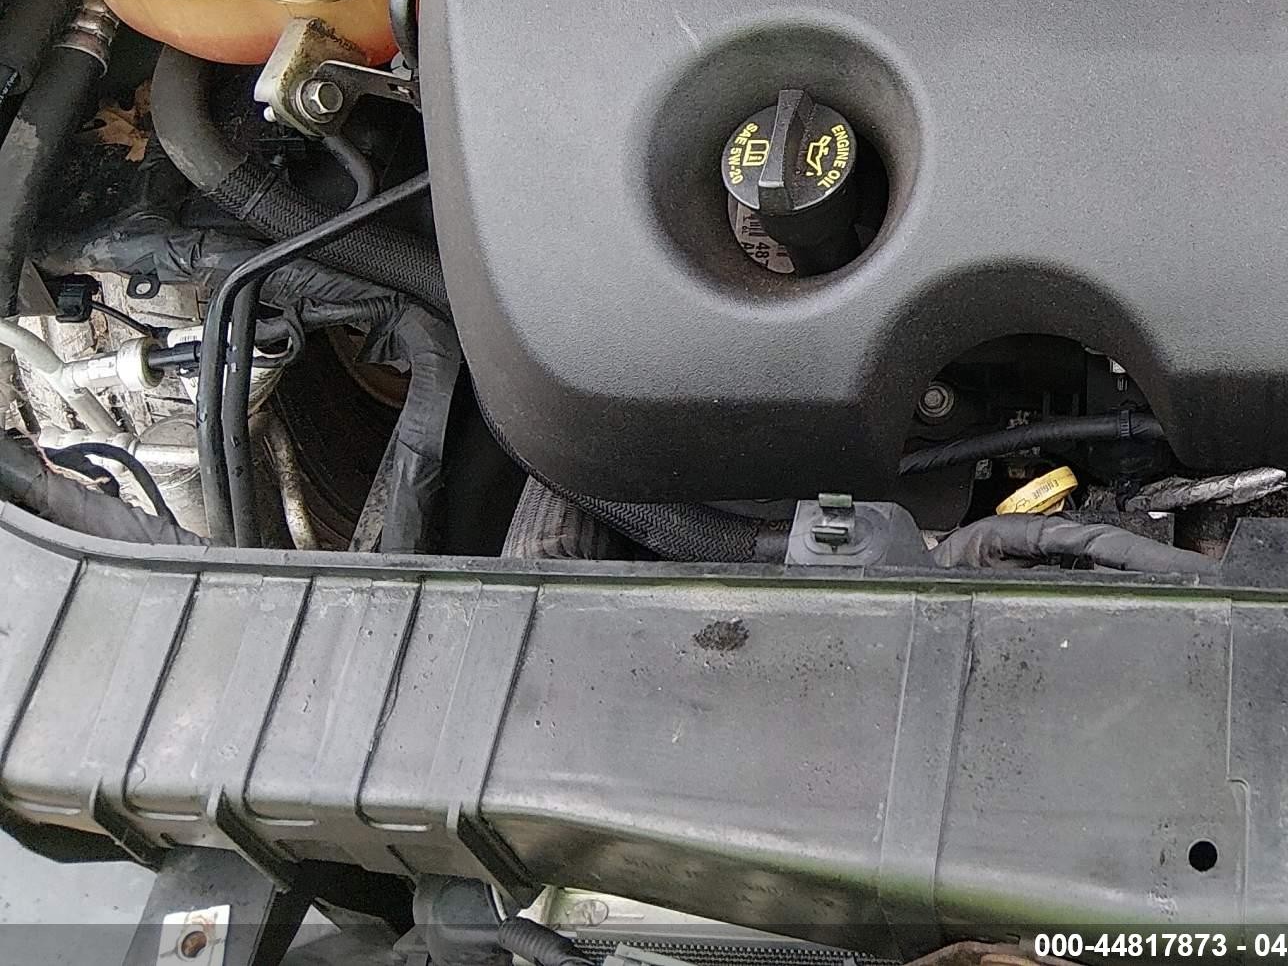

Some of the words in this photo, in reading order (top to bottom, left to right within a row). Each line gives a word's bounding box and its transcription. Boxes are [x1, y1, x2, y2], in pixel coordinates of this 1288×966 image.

[735, 122, 759, 146] SAE
[831, 124, 850, 169] ENGINE
[729, 146, 744, 185] 5W-20
[817, 170, 841, 189] OIL
[1031, 478, 1059, 500] ENGINE
